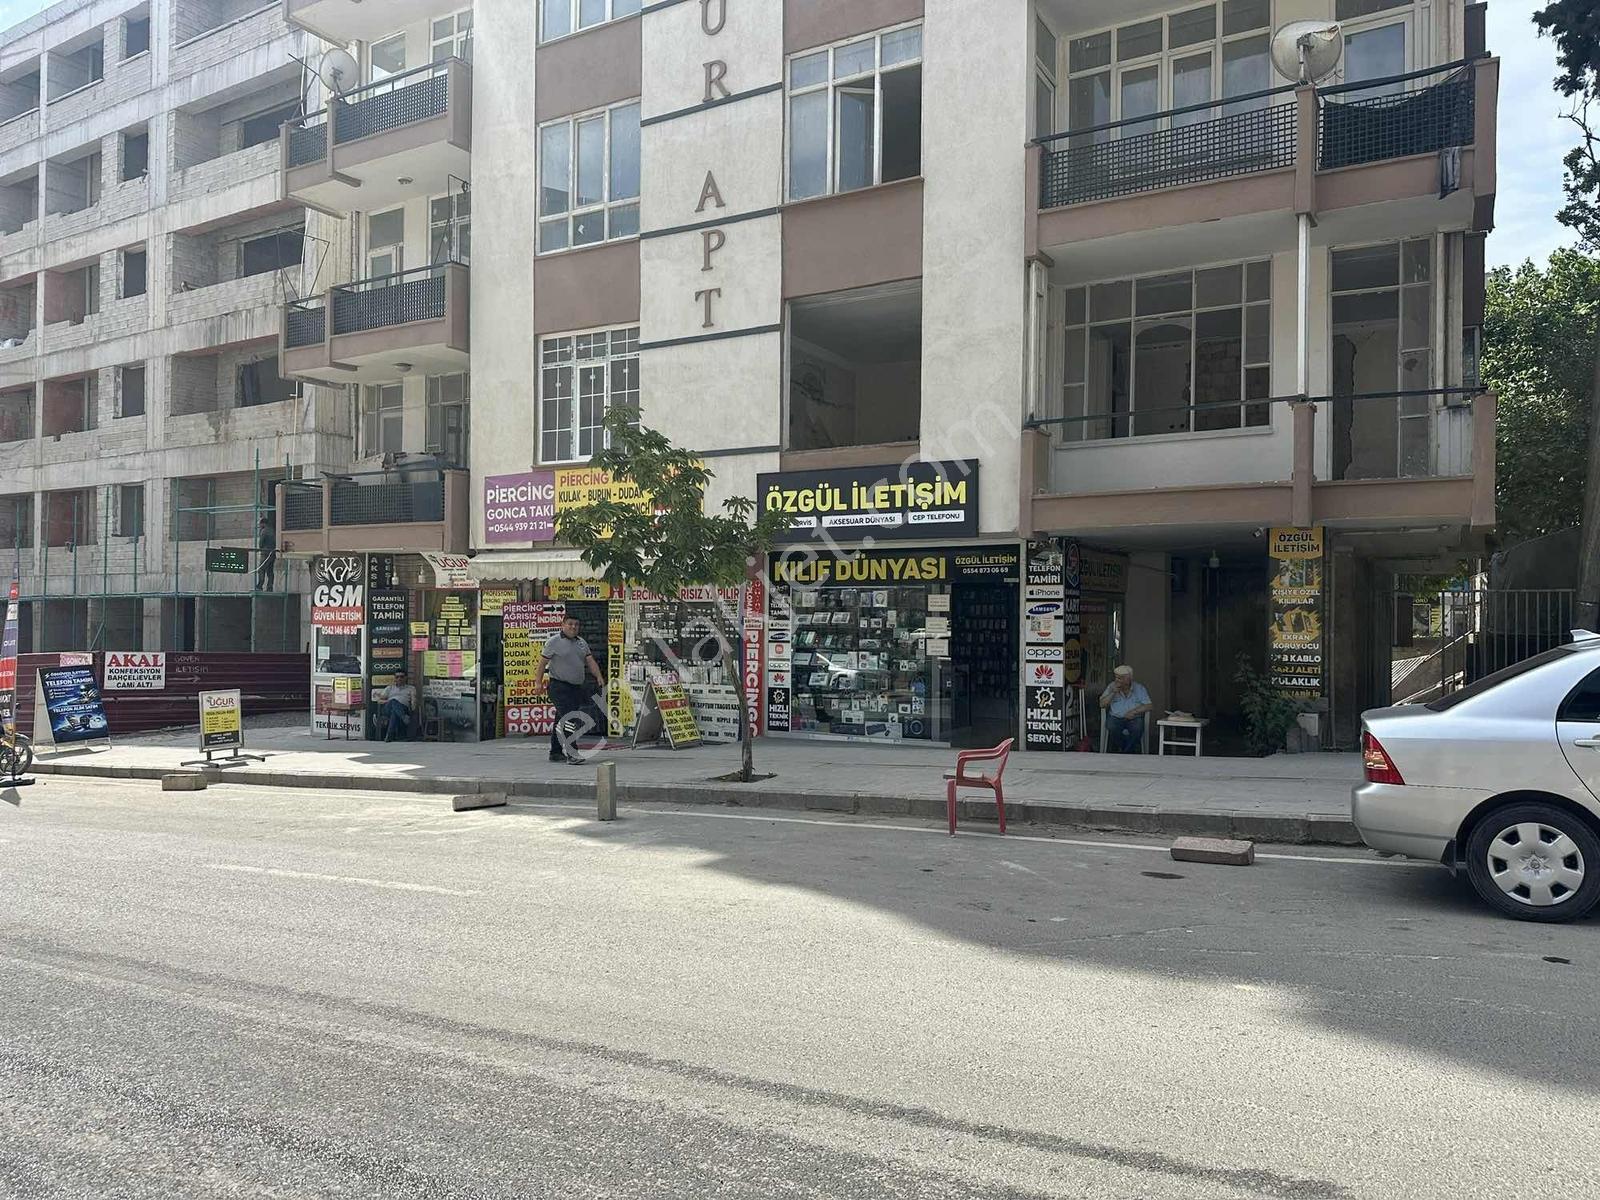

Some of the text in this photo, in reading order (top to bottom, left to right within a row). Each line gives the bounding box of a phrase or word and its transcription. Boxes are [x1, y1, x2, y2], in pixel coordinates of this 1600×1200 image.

[694, 170, 726, 329] APT
[559, 489, 581, 503] KULAK
[766, 475, 967, 514] ÖZGÜL İLETİŞİM
[487, 507, 528, 520] GONCA
[529, 505, 554, 517] TAKI
[829, 518, 864, 526] AKSESUAR
[865, 515, 896, 524] DÜNYASI
[912, 513, 926, 521] CEP
[926, 512, 960, 520] TELEFONU
[494, 521, 547, 533] 0544 939 21 21
[1278, 531, 1315, 542] ÖZGÜL
[1273, 542, 1320, 553] İLETİŞİM
[955, 553, 1017, 565] ÖZGÜL İLETİŞİM
[774, 552, 947, 582] KILIF DÜNYASI
[1028, 573, 1061, 584] TAMİRİ
[314, 585, 364, 608] GSM
[1035, 588, 1060, 596] iPhone
[313, 609, 335, 621] GÜVEN
[372, 610, 405, 620] TAMİRİ
[503, 611, 538, 621] AĞRISIZ
[379, 637, 404, 645] iPhone
[1272, 642, 1320, 650] KORUYUCU
[1027, 648, 1062, 658] oppo
[1289, 654, 1322, 663] KABLO
[107, 654, 164, 667] AKAL
[505, 668, 530, 676] HIZMA
[1295, 665, 1321, 674] ALETİ
[507, 706, 557, 722] GEÇİC
[769, 704, 789, 713] HIZLI
[1026, 708, 1062, 720] HIZLI
[508, 719, 554, 733] DÖVM
[1026, 720, 1062, 731] TEKNİK
[1026, 732, 1062, 744] SERVİS
